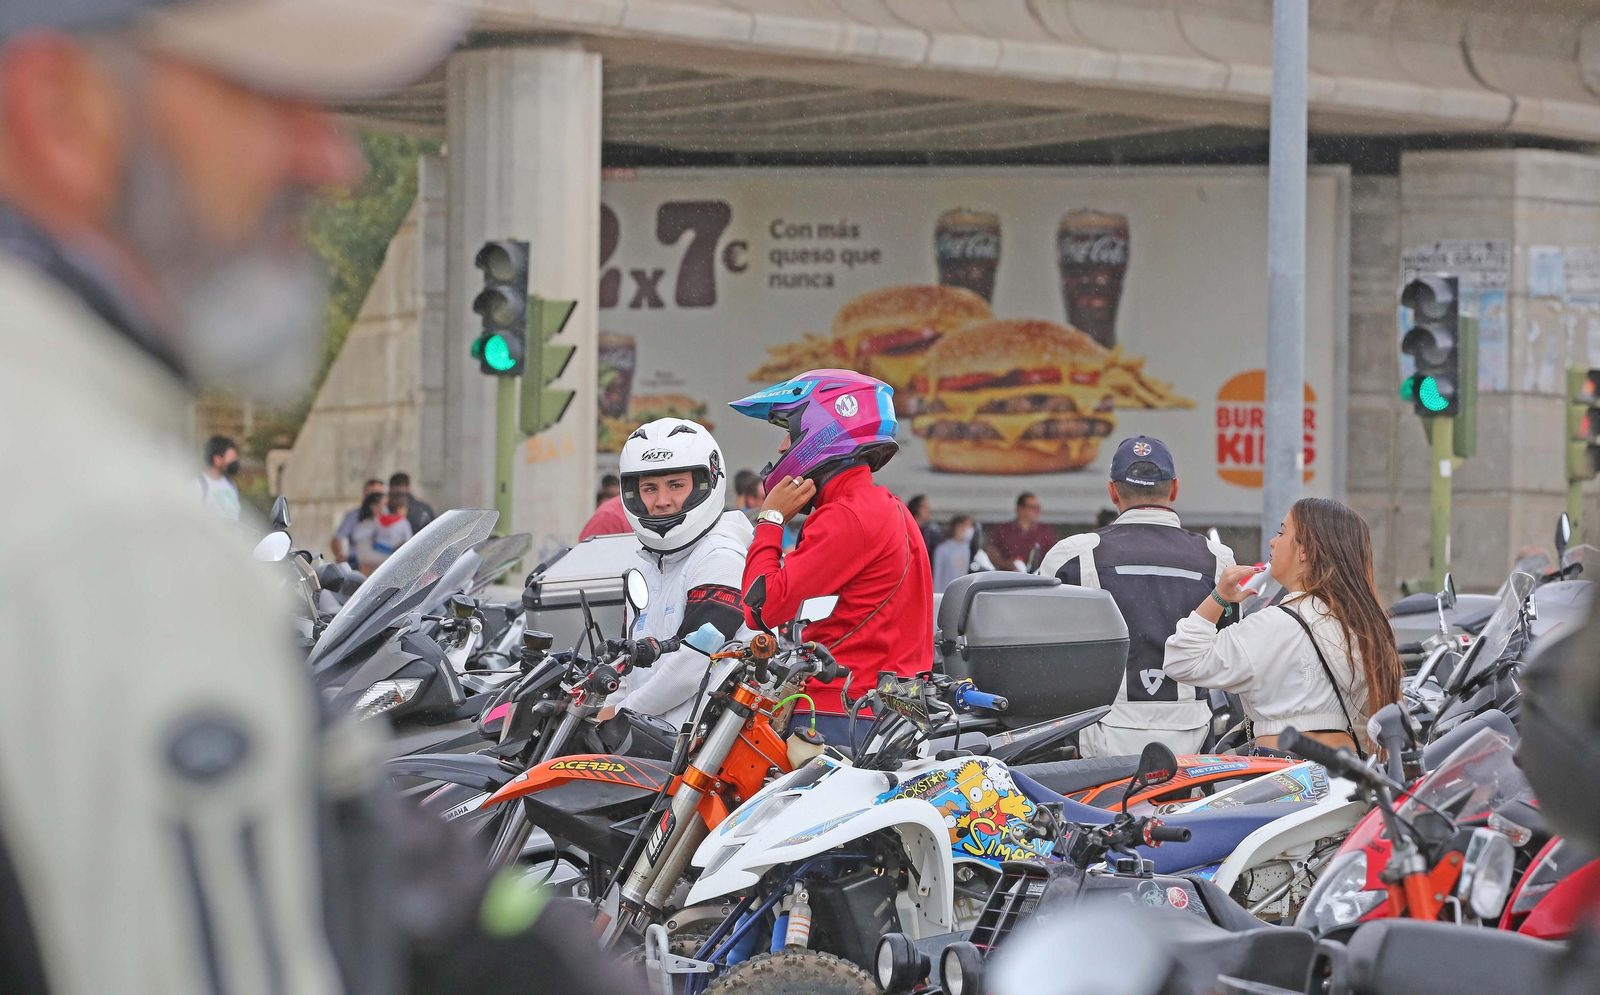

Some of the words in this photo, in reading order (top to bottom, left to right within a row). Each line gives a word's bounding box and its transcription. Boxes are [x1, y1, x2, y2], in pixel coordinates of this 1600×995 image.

[769, 218, 813, 240] Con
[817, 219, 860, 240] más
[769, 247, 836, 267] queso
[840, 249, 882, 269] que
[769, 270, 835, 289] nunca
[1216, 406, 1316, 430] BURR
[795, 421, 839, 468] FALCON
[1216, 432, 1316, 466] KIG
[1190, 763, 1236, 775] METZELER
[446, 805, 469, 819] MAHA
